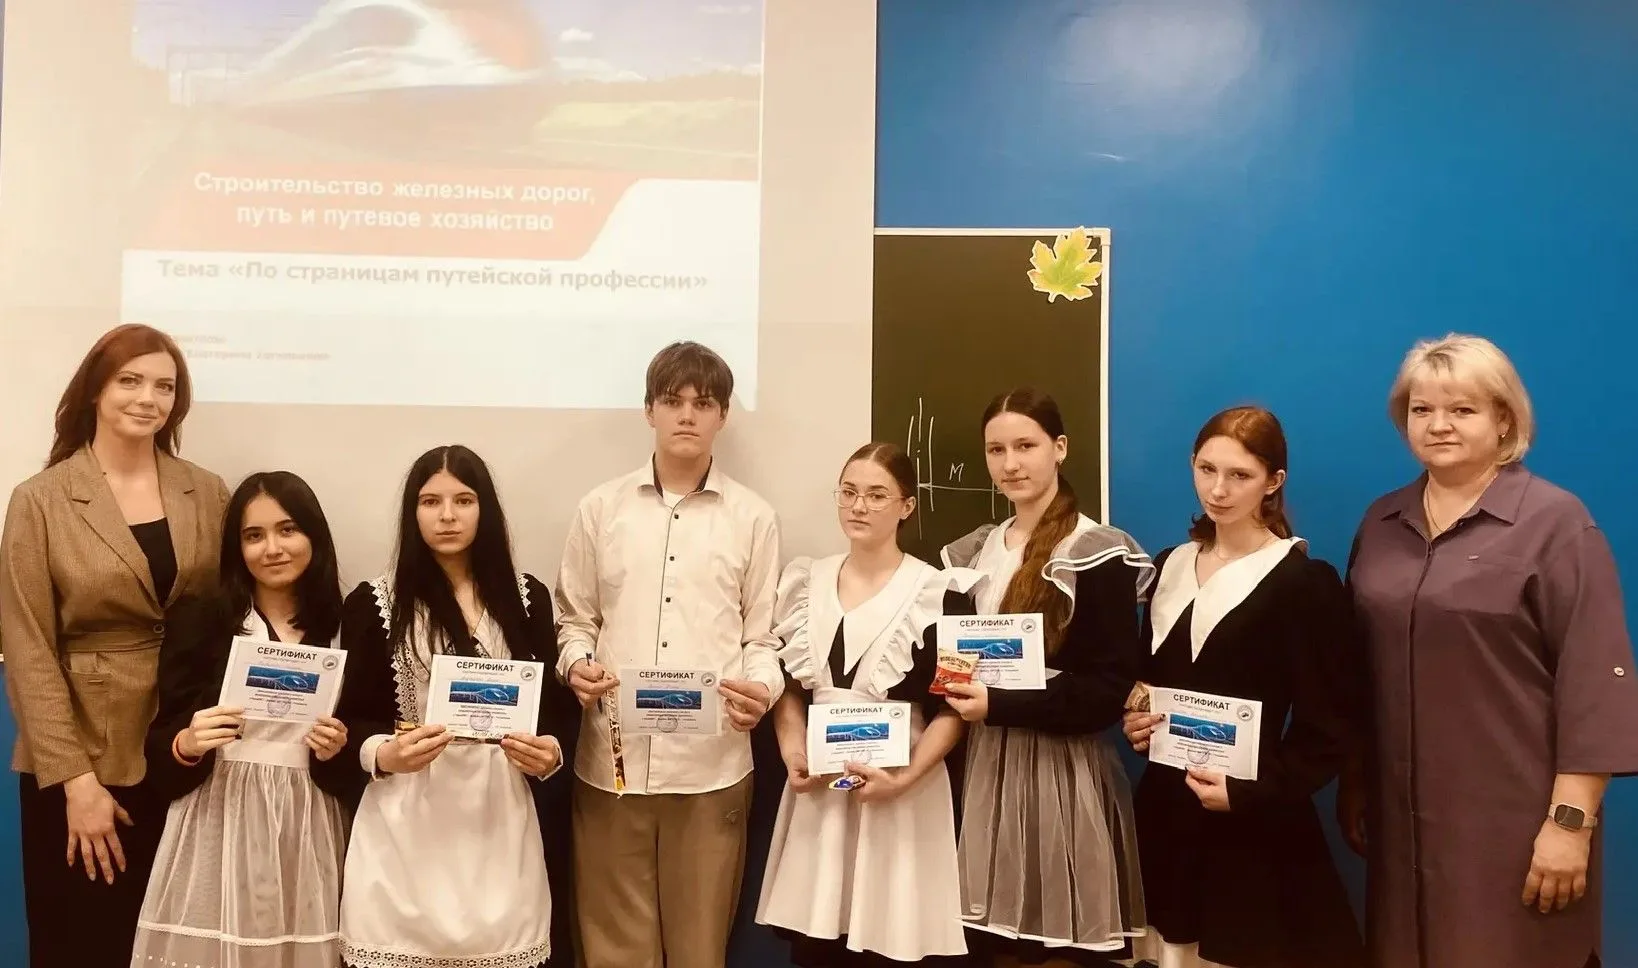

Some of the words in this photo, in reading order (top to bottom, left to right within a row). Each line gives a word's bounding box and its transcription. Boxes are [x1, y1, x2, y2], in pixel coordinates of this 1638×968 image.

[194, 172, 383, 196] Строительство
[393, 182, 515, 200] железных
[521, 185, 596, 206] дорог,
[237, 206, 293, 228] путь
[301, 208, 315, 225] и
[324, 208, 421, 230] путевое
[429, 209, 554, 232] хозяйство
[158, 259, 220, 278] Тема
[229, 261, 277, 280] «По
[286, 265, 419, 284] страницам
[427, 267, 552, 288] путейской
[560, 269, 708, 293] профессии»
[959, 619, 1015, 628] СЕРТИФИКАТ
[257, 646, 318, 661] СЕРТИФИКАТ
[456, 661, 515, 672] СЕРТИФИКАТ
[639, 671, 695, 680] СЕРТИФИКАТ
[1173, 693, 1231, 711] СЕРТИФИКАТ
[830, 707, 884, 716] СЕРТИФИКАТ
